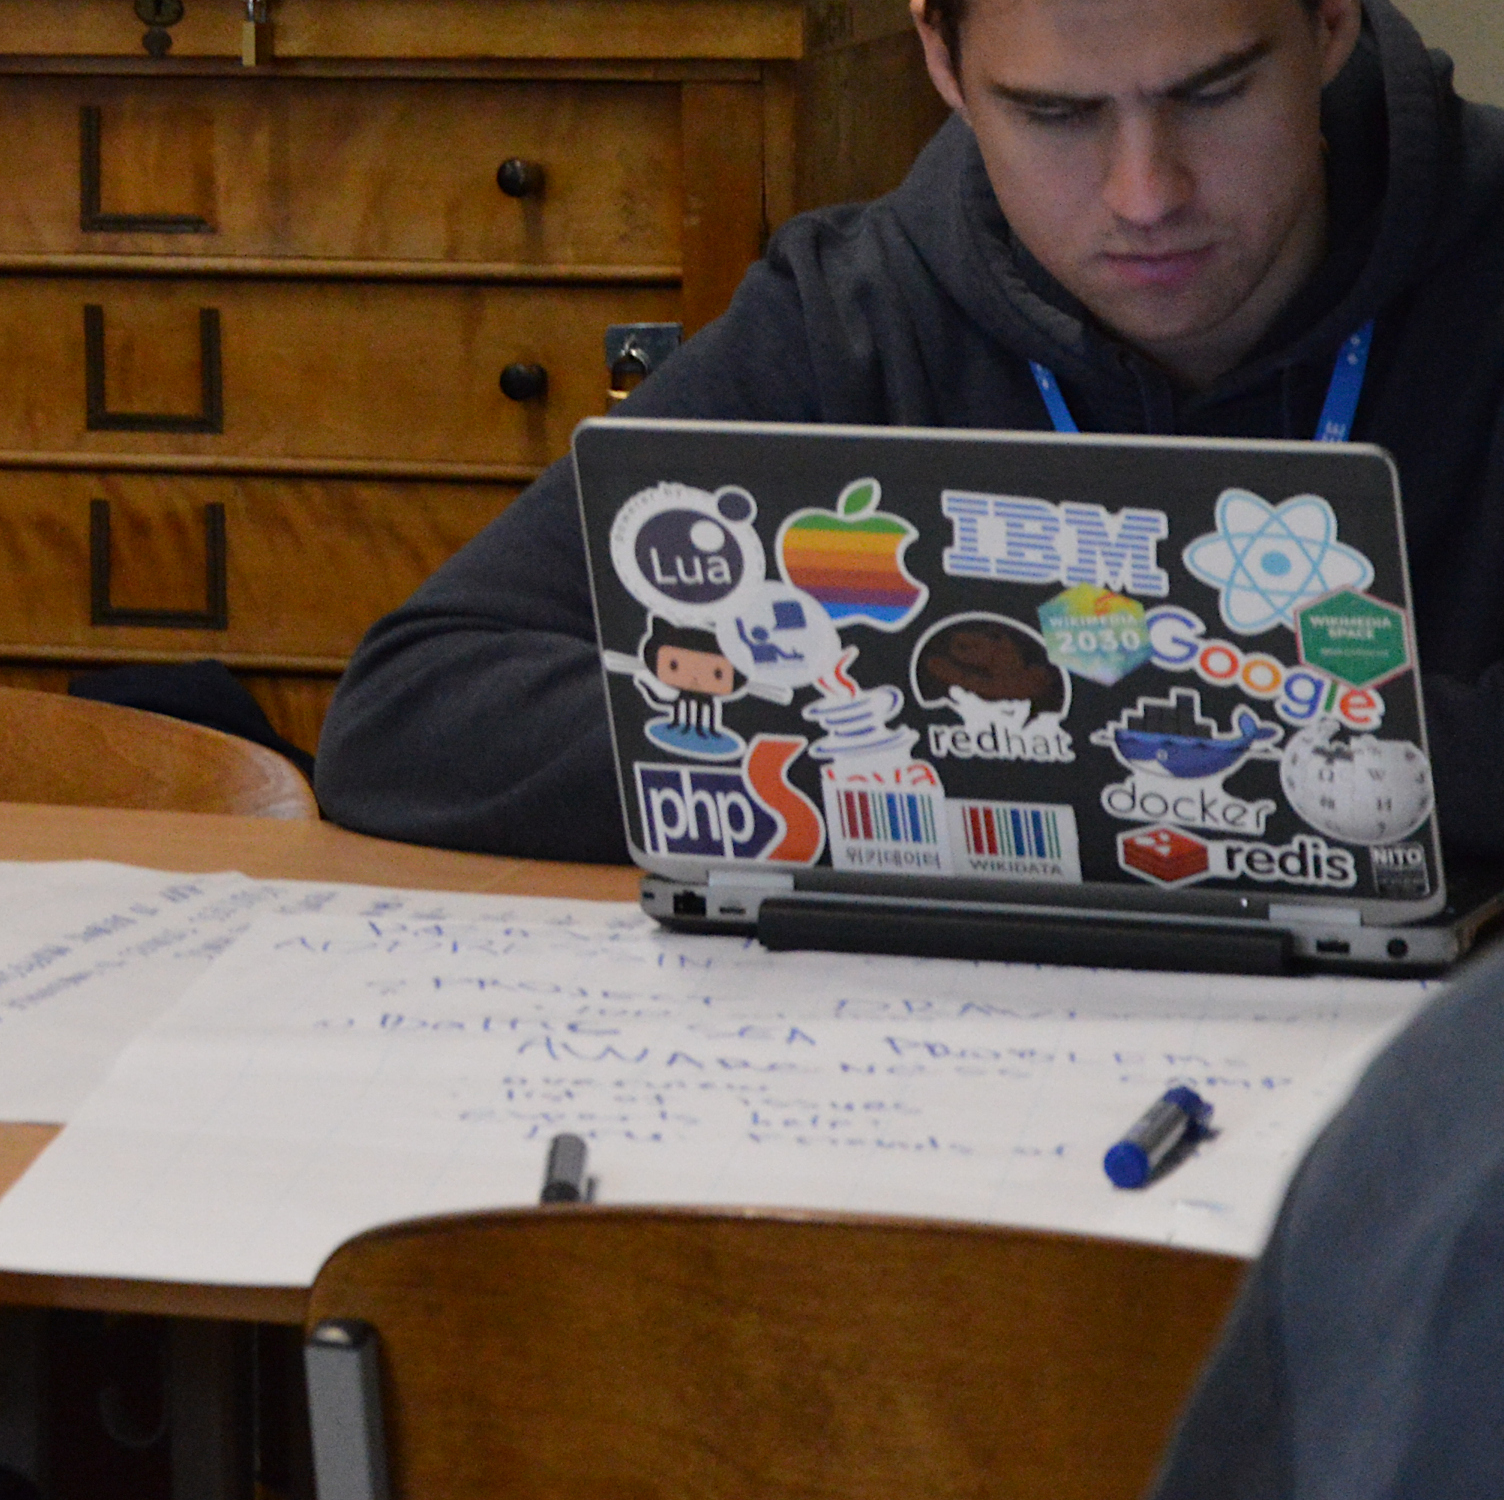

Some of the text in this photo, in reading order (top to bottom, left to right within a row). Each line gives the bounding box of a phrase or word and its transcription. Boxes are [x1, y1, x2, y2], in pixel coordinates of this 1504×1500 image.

[946, 496, 1162, 591] IBM
[649, 546, 732, 585] Lua
[1049, 611, 1140, 628] WIKIMEDIA
[1310, 615, 1392, 630] WIKIMEDIA
[1327, 627, 1375, 641] SPACE
[1054, 629, 1140, 654] 2030
[1147, 611, 1376, 724] Google
[932, 725, 1072, 756] redhat
[648, 768, 756, 860] php
[1106, 782, 1274, 830] docker
[969, 858, 1064, 877] WIKIDATA
[1226, 840, 1349, 882] redis
